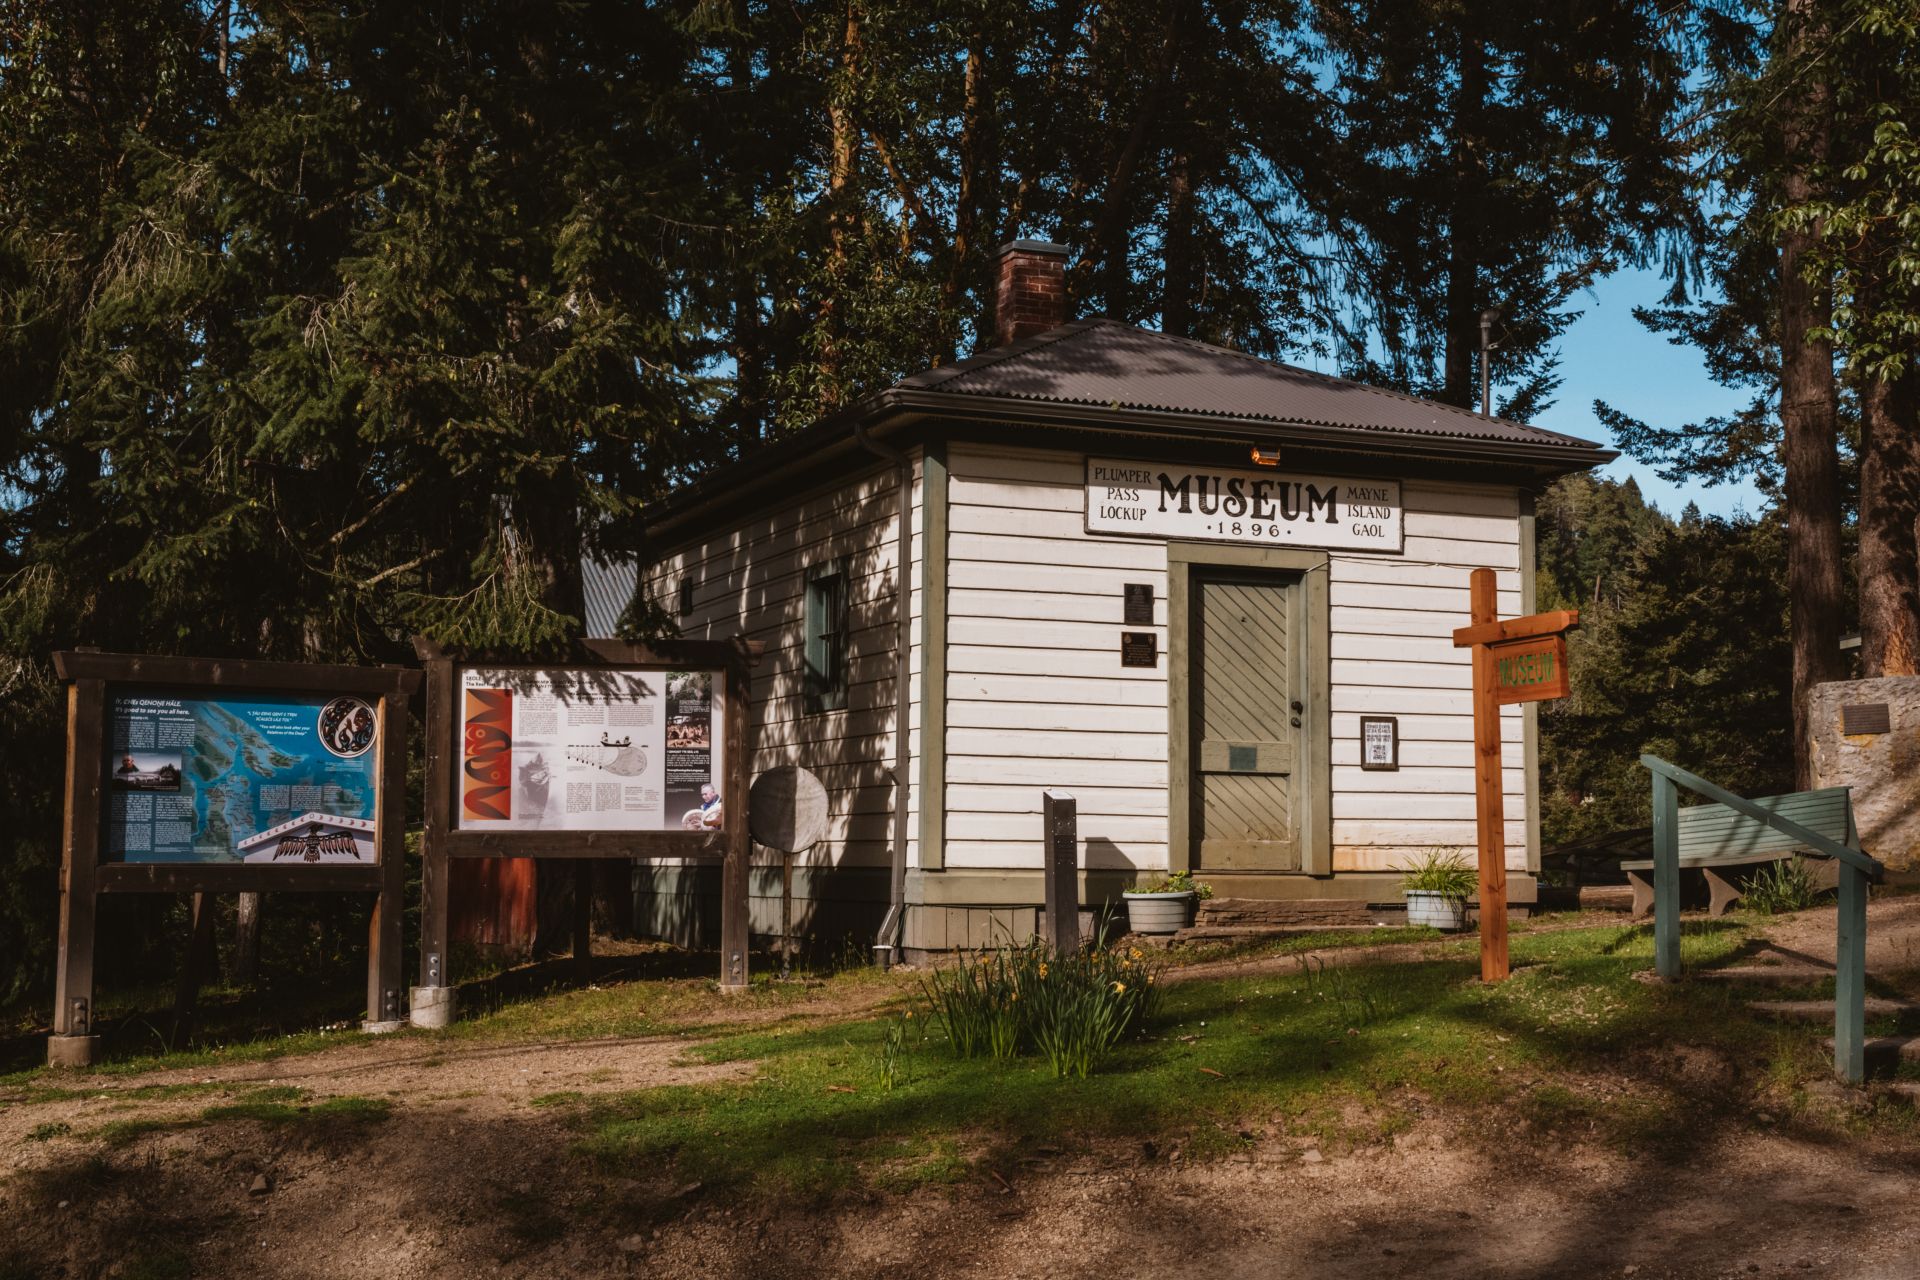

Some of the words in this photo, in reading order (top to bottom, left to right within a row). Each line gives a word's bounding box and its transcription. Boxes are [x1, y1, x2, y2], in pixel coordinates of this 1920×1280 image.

[1095, 467, 1152, 484] PLUMPER
[1107, 487, 1140, 502] PASS
[1157, 472, 1339, 524] MUSEUM
[1346, 487, 1389, 502] MAYNE
[1100, 505, 1147, 521] LOCKUP
[1347, 505, 1391, 520] ISLAND
[1352, 523, 1385, 538] GAOL
[1499, 652, 1554, 689] MUSEUM
[123, 707, 139, 715] good
